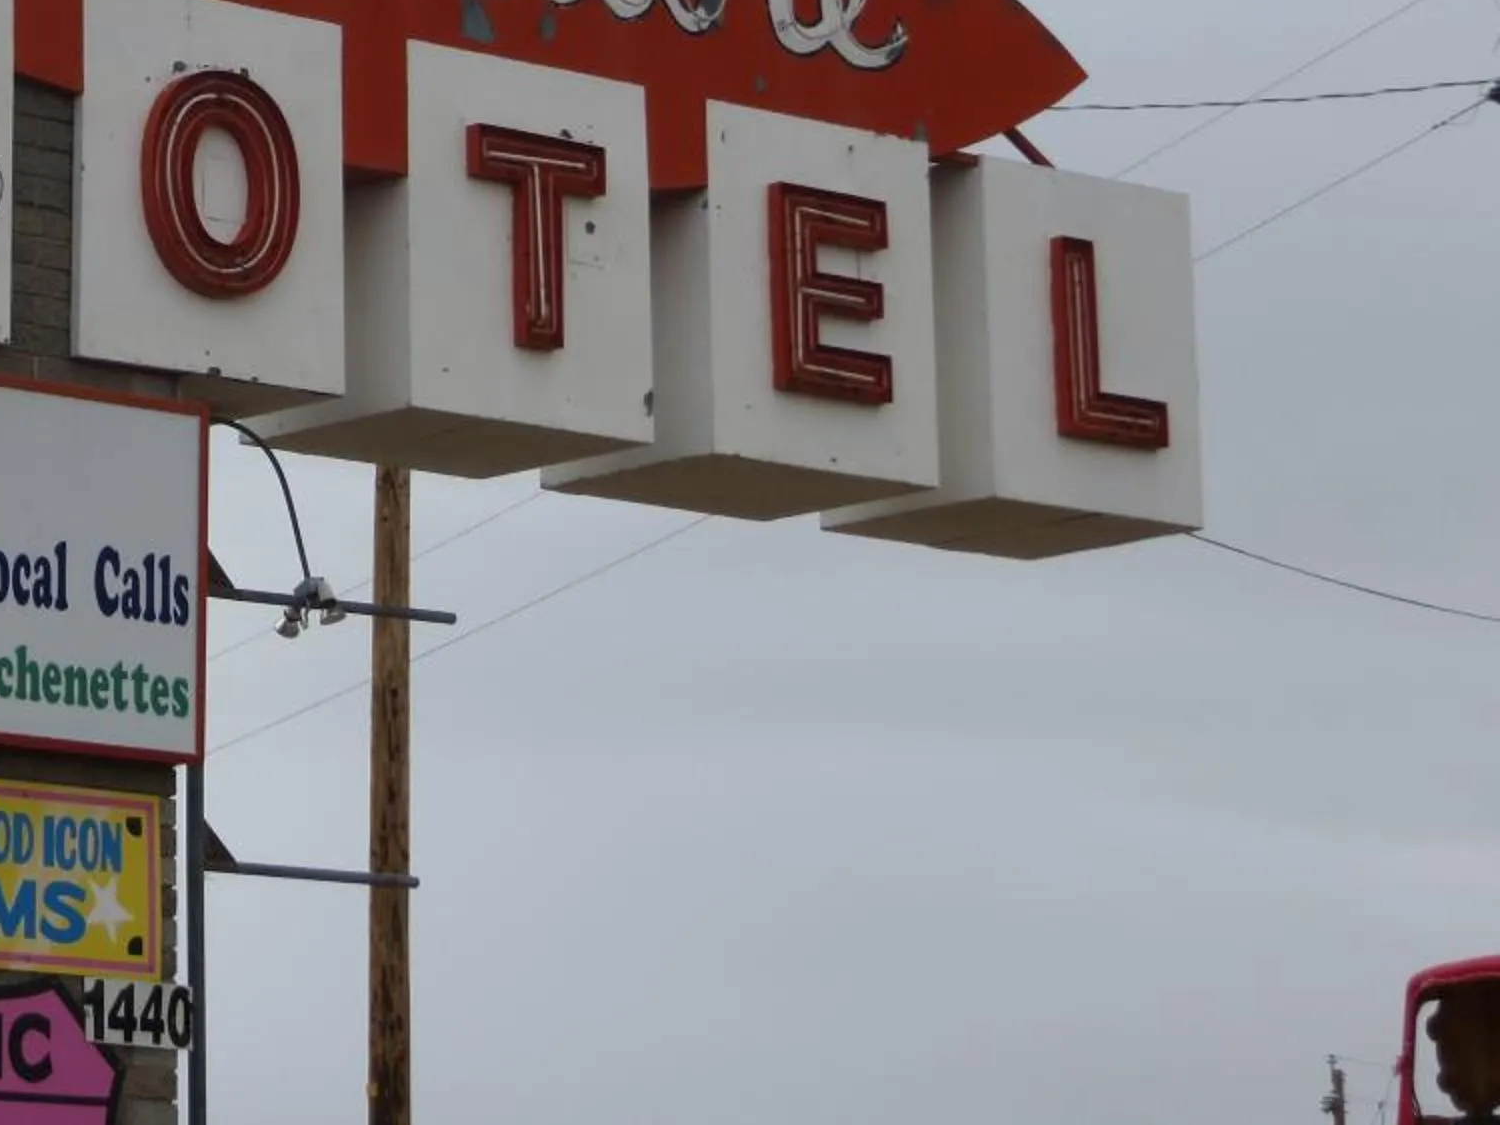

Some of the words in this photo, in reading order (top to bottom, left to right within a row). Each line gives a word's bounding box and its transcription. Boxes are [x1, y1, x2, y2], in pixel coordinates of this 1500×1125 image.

[94, 546, 190, 626] Calls
[42, 811, 122, 873] ICON
[83, 979, 190, 1048] 1440
